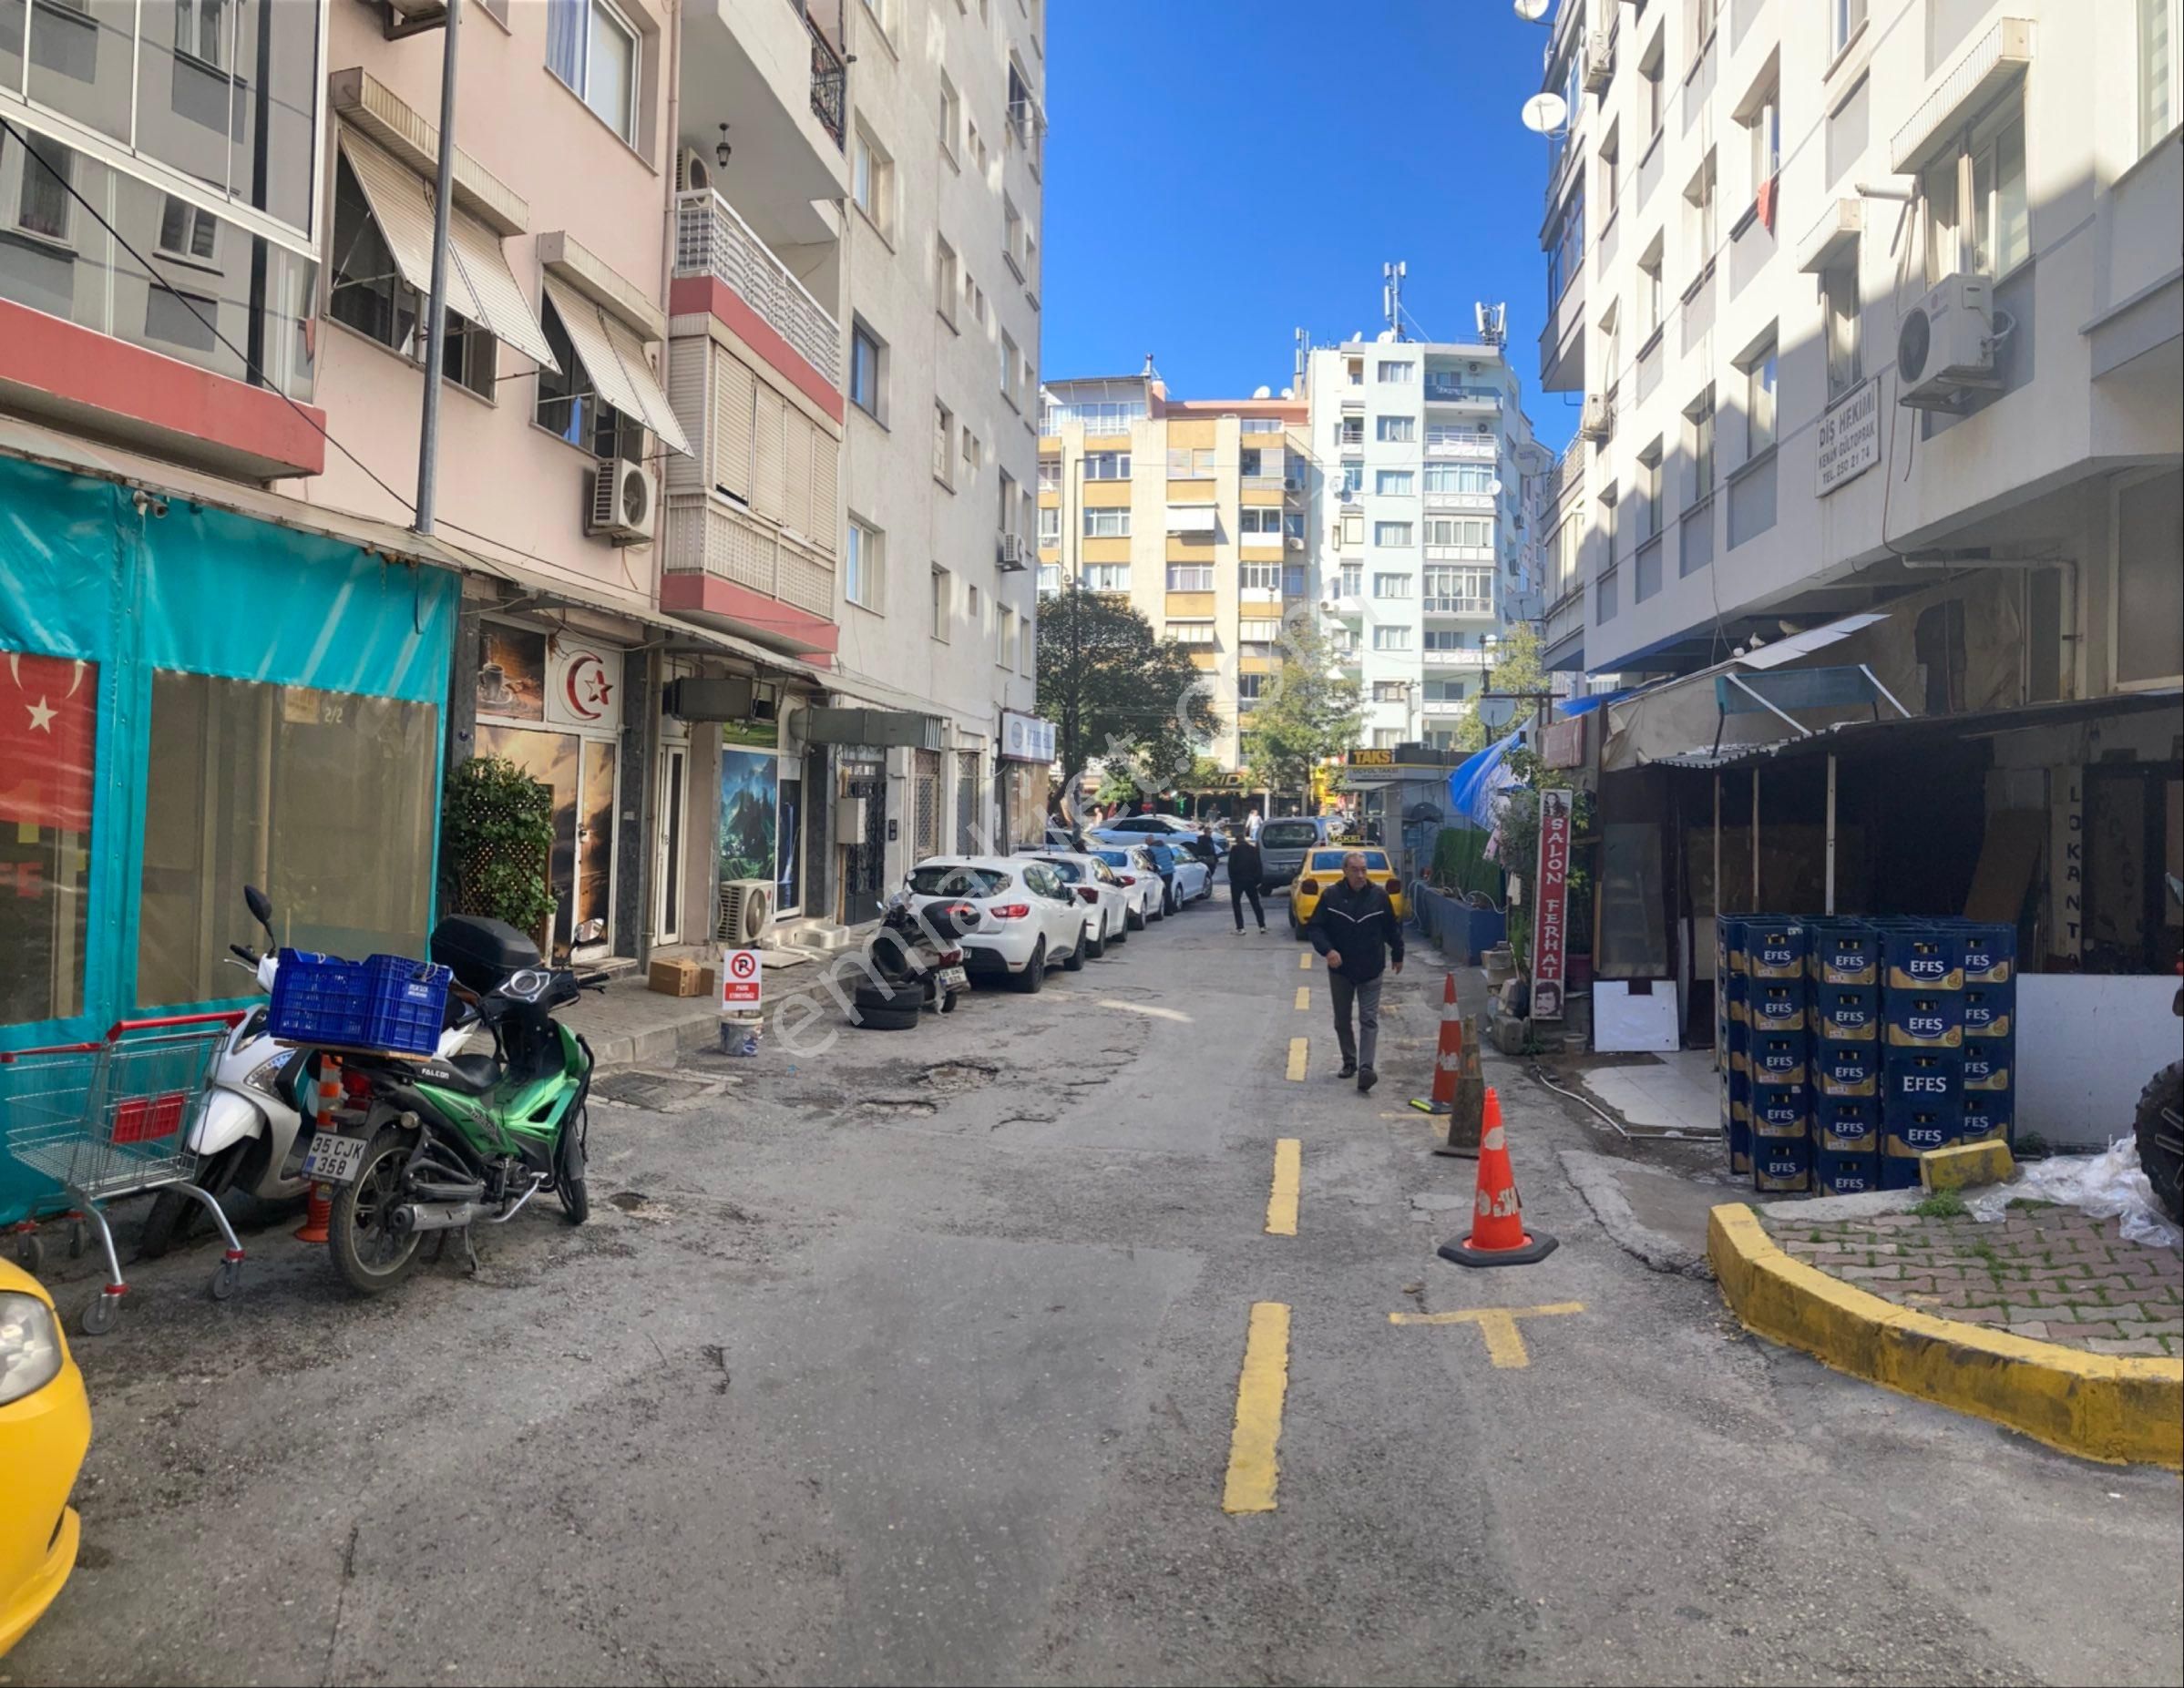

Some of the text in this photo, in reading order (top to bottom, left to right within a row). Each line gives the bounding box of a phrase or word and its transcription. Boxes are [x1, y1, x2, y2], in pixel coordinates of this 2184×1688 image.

[1820, 419, 1835, 448] DİŞ
[324, 705, 343, 724] 2/2
[1545, 819, 1564, 885] SALON
[1542, 899, 1560, 978] FERHAT
[1764, 950, 1791, 961] EFES
[1835, 956, 1864, 967] EFES
[1965, 955, 1990, 967] FES
[1910, 960, 1944, 973] EFES
[1765, 1003, 1792, 1014] EFES
[1965, 1008, 1990, 1020] FES
[1836, 1011, 1864, 1022] EFES
[1909, 1018, 1943, 1030] EFES
[1766, 1056, 1793, 1067] EFES
[422, 1068, 449, 1079] FALCON
[1835, 1067, 1863, 1078] EFES
[1965, 1062, 1989, 1074] FES
[1902, 1077, 1947, 1092] EFES
[1768, 1109, 1794, 1120] EFES
[1835, 1122, 1864, 1133] EFES
[1964, 1116, 1989, 1128] FES
[1908, 1129, 1943, 1142] EFES
[313, 1137, 364, 1160] 35 CJK
[318, 1157, 346, 1175] 358
[1769, 1162, 1796, 1173] EFES
[1835, 1178, 1864, 1189] EFES
